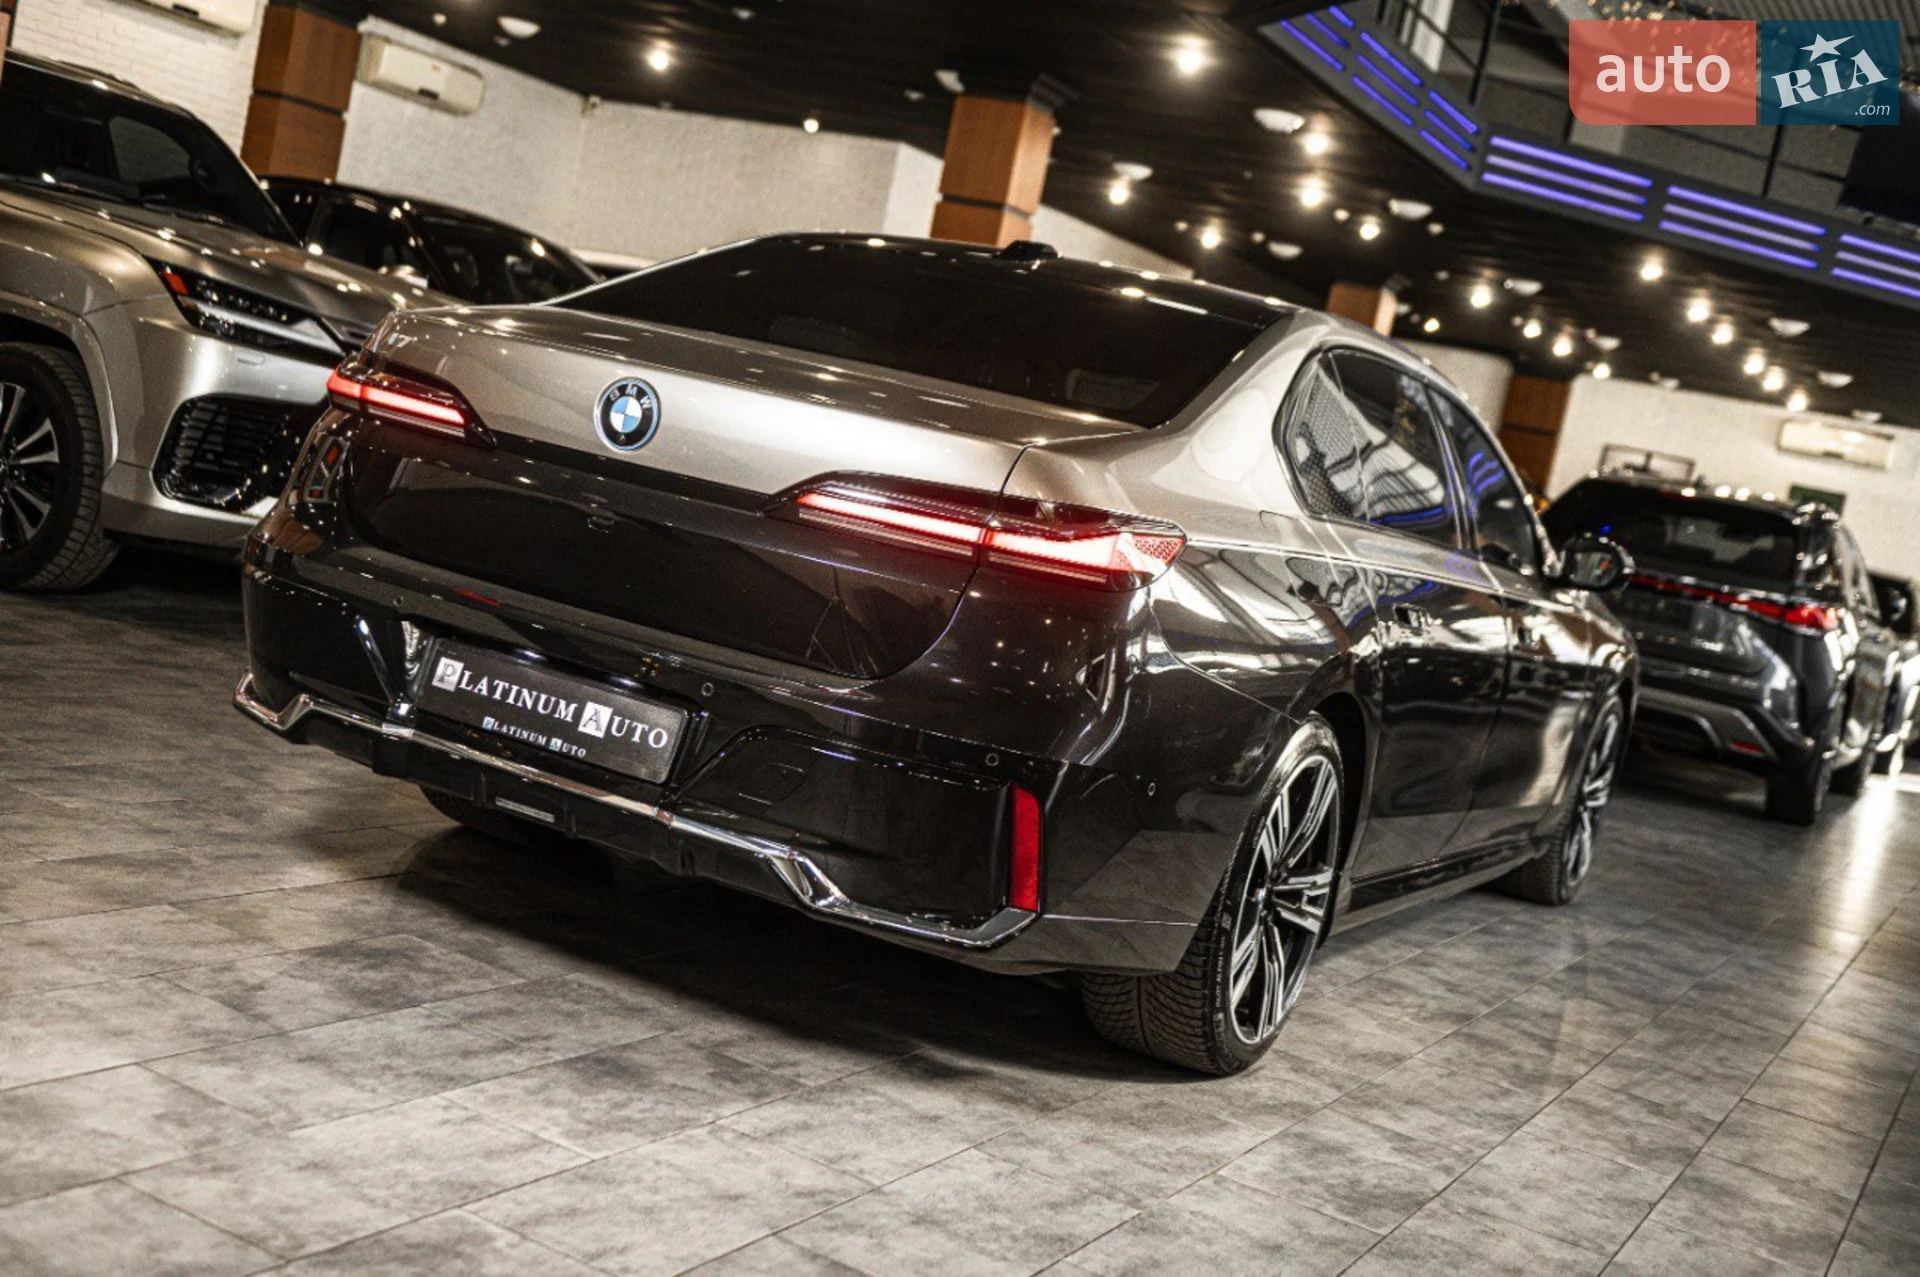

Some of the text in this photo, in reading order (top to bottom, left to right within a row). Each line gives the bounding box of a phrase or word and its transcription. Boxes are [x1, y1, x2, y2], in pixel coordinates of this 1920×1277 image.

[609, 383, 652, 409] BMW
[431, 656, 669, 750] PLATINUM AUTO
[482, 716, 588, 758] PLATINUM AUTO
